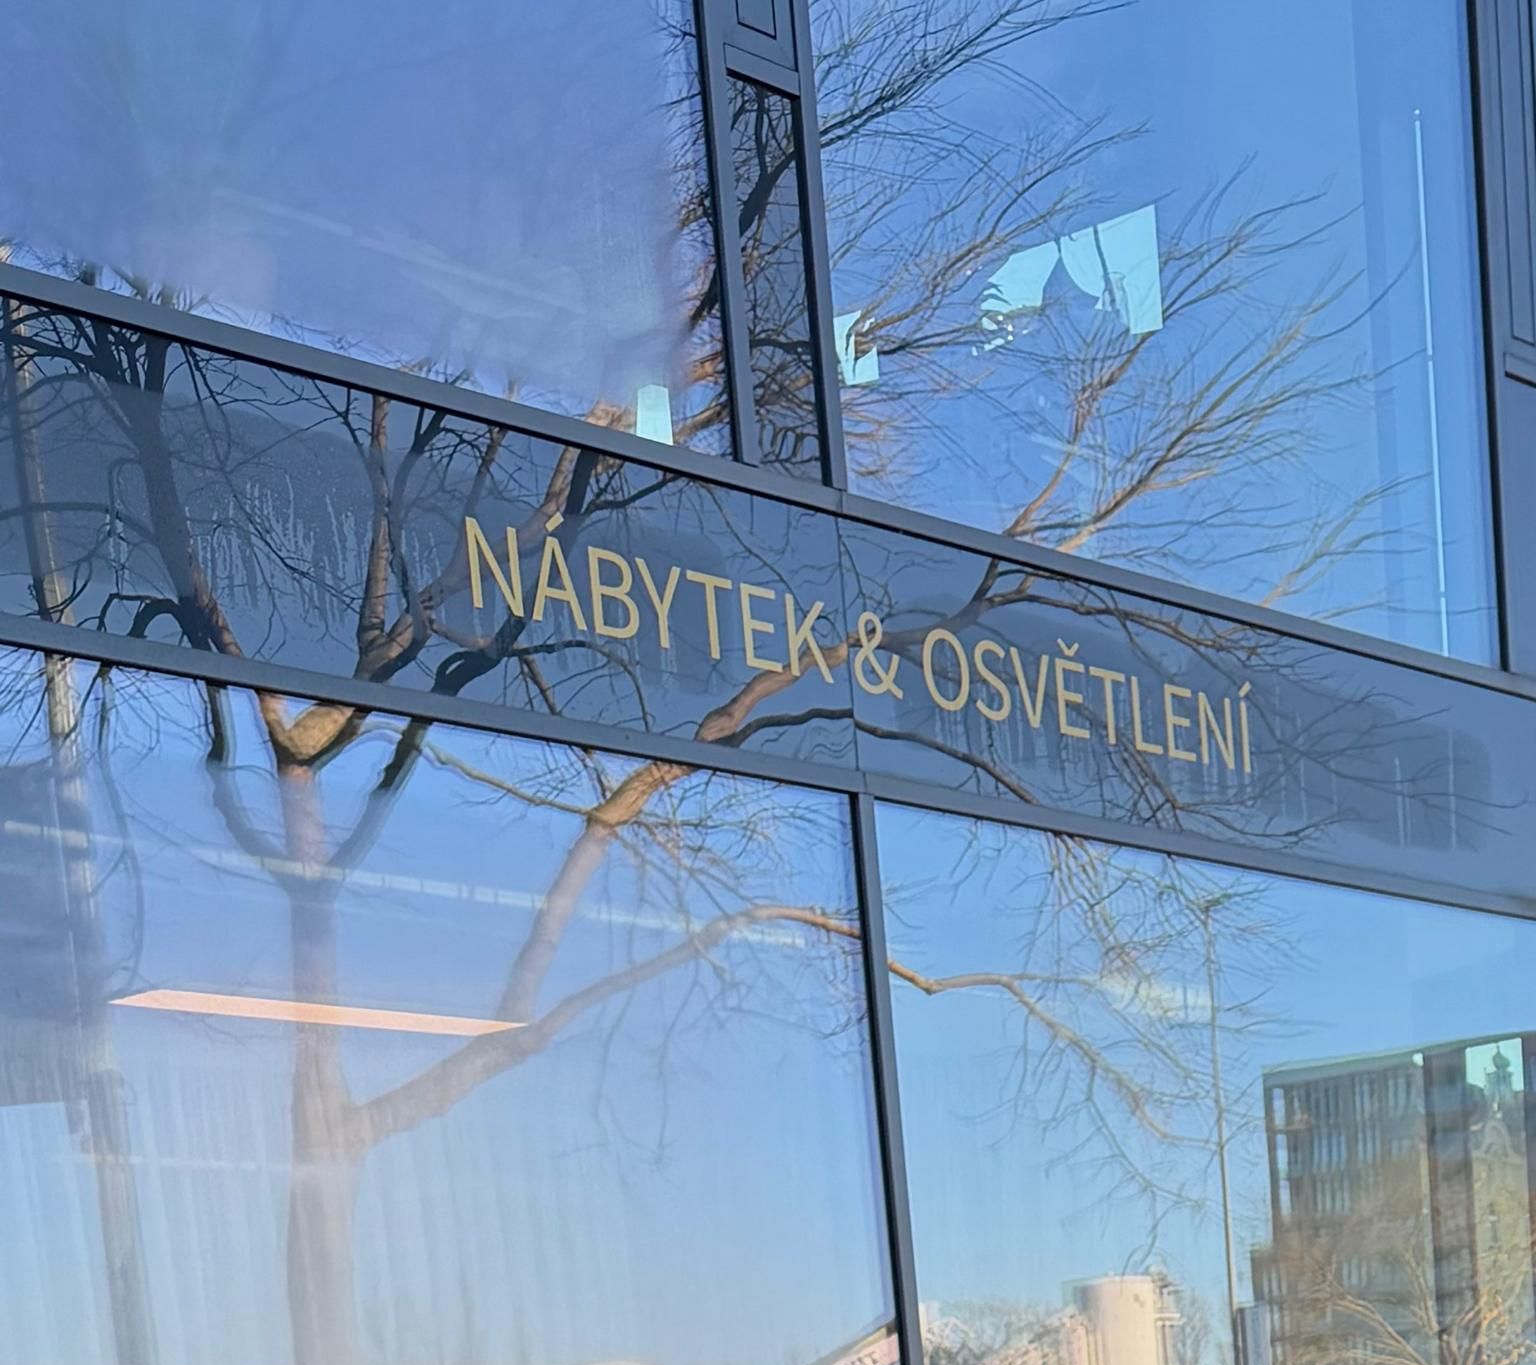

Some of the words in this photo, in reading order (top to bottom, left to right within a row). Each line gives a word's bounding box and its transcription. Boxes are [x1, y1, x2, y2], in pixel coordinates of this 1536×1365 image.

[463, 512, 837, 684] NÁBYTEK
[853, 610, 904, 699] &
[923, 627, 1252, 774] OSVĚTLENÍ
